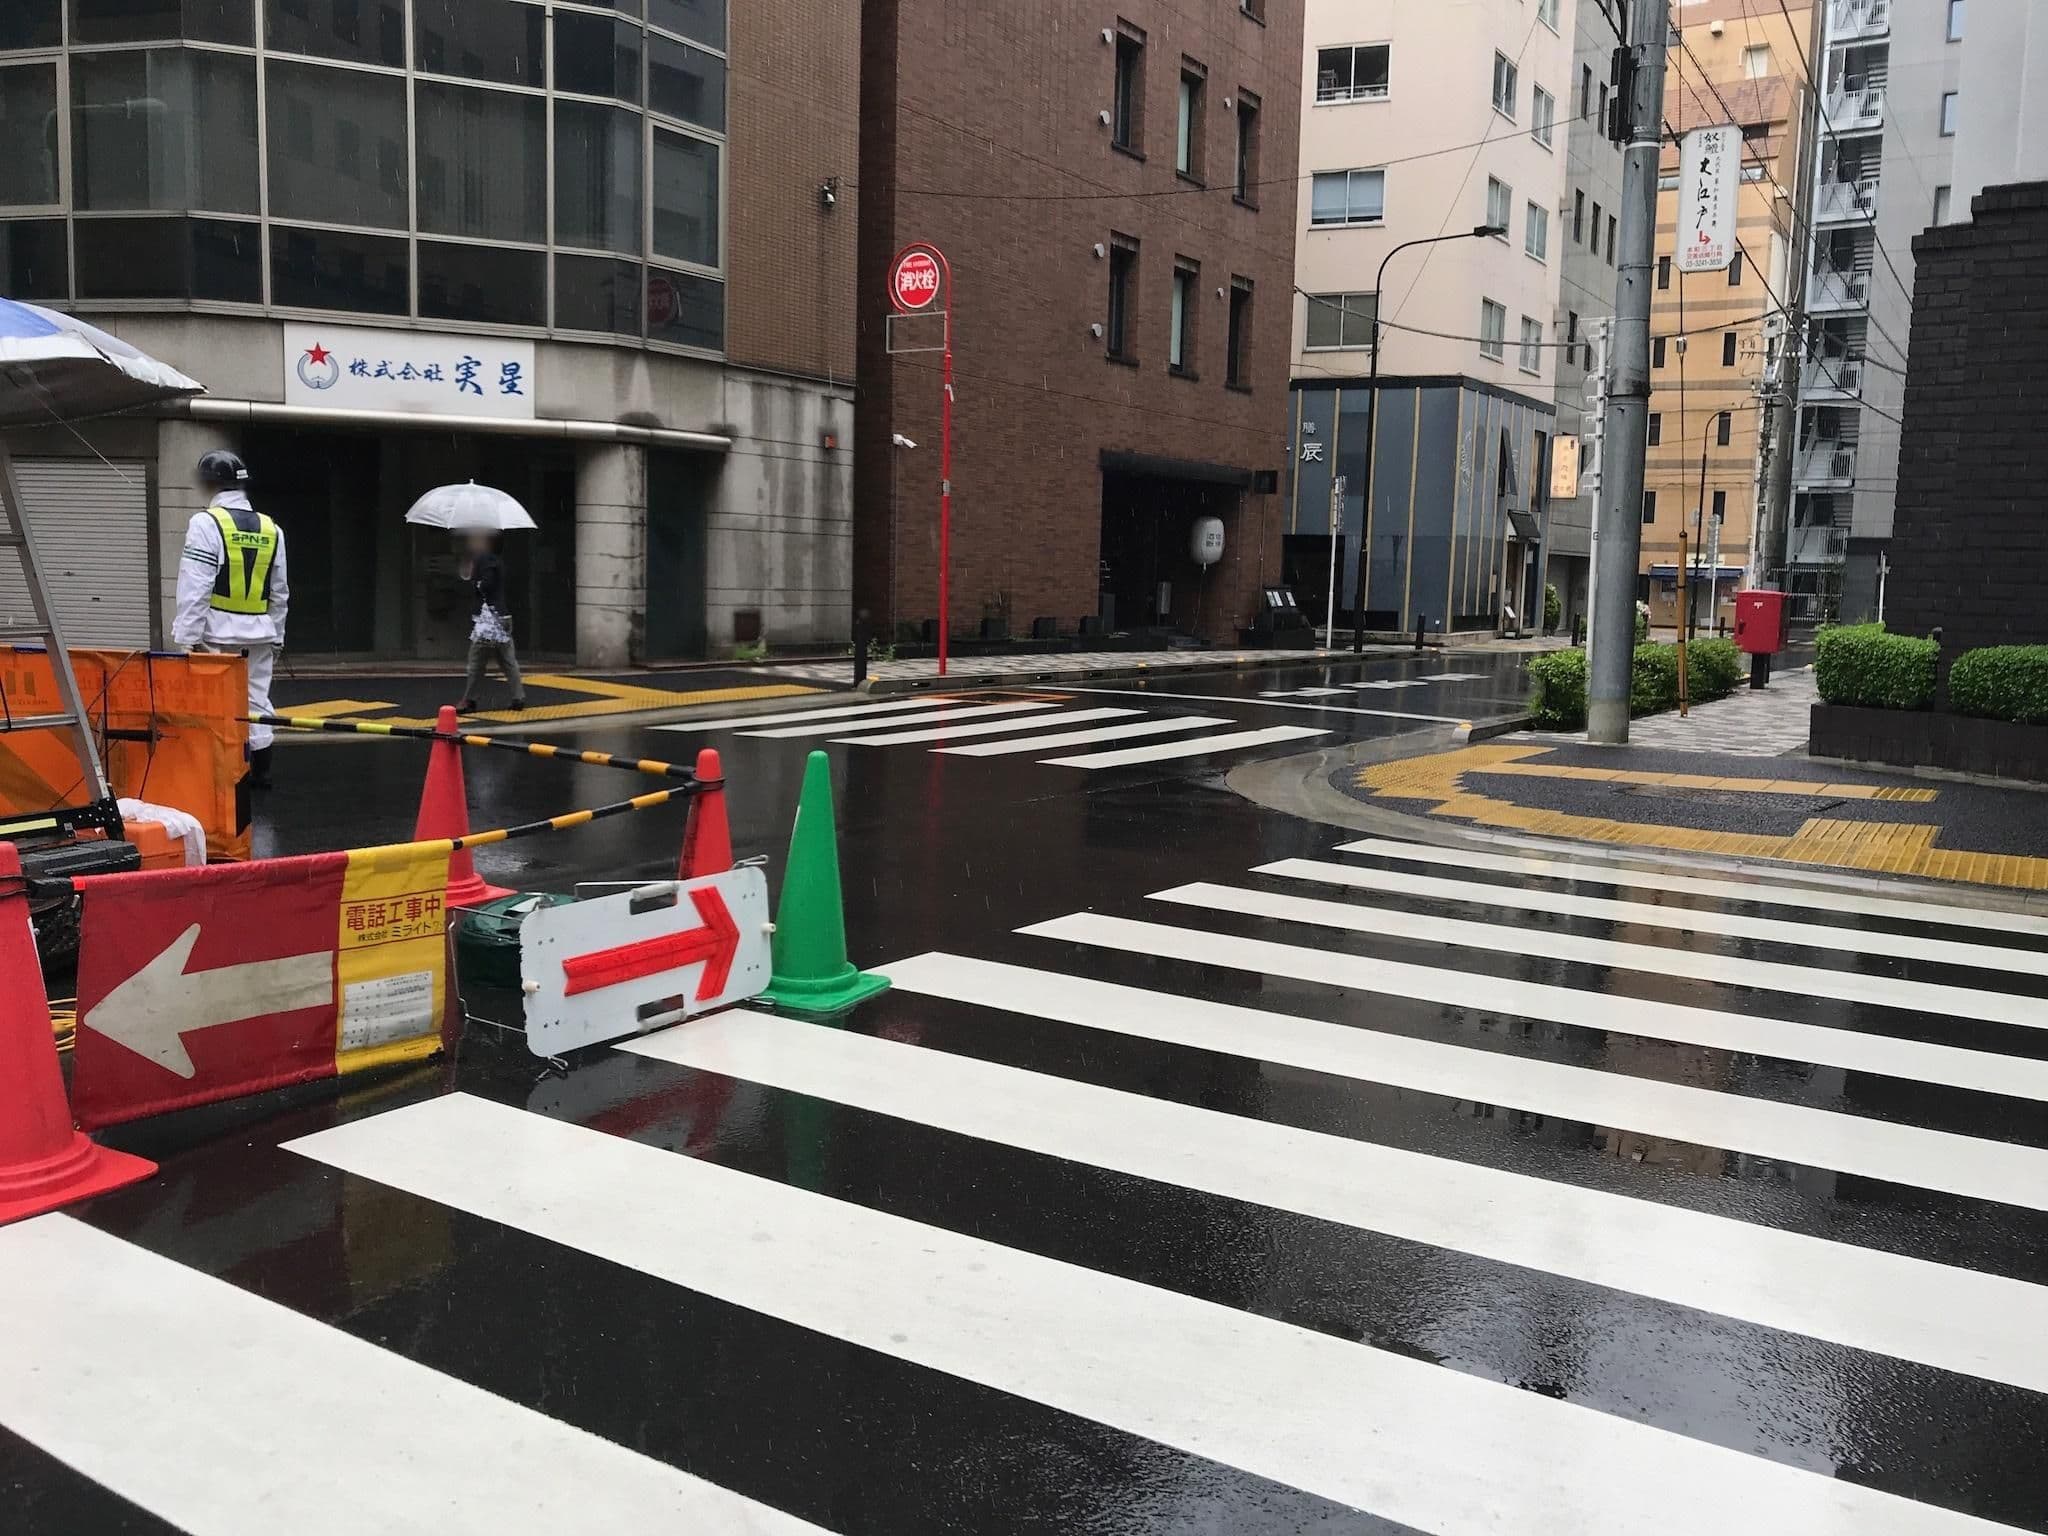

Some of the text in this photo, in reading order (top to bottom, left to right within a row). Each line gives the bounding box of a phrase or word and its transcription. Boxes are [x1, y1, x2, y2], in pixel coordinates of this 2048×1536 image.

[900, 268, 935, 292] 消火栓
[346, 894, 440, 931] 電話工事中
